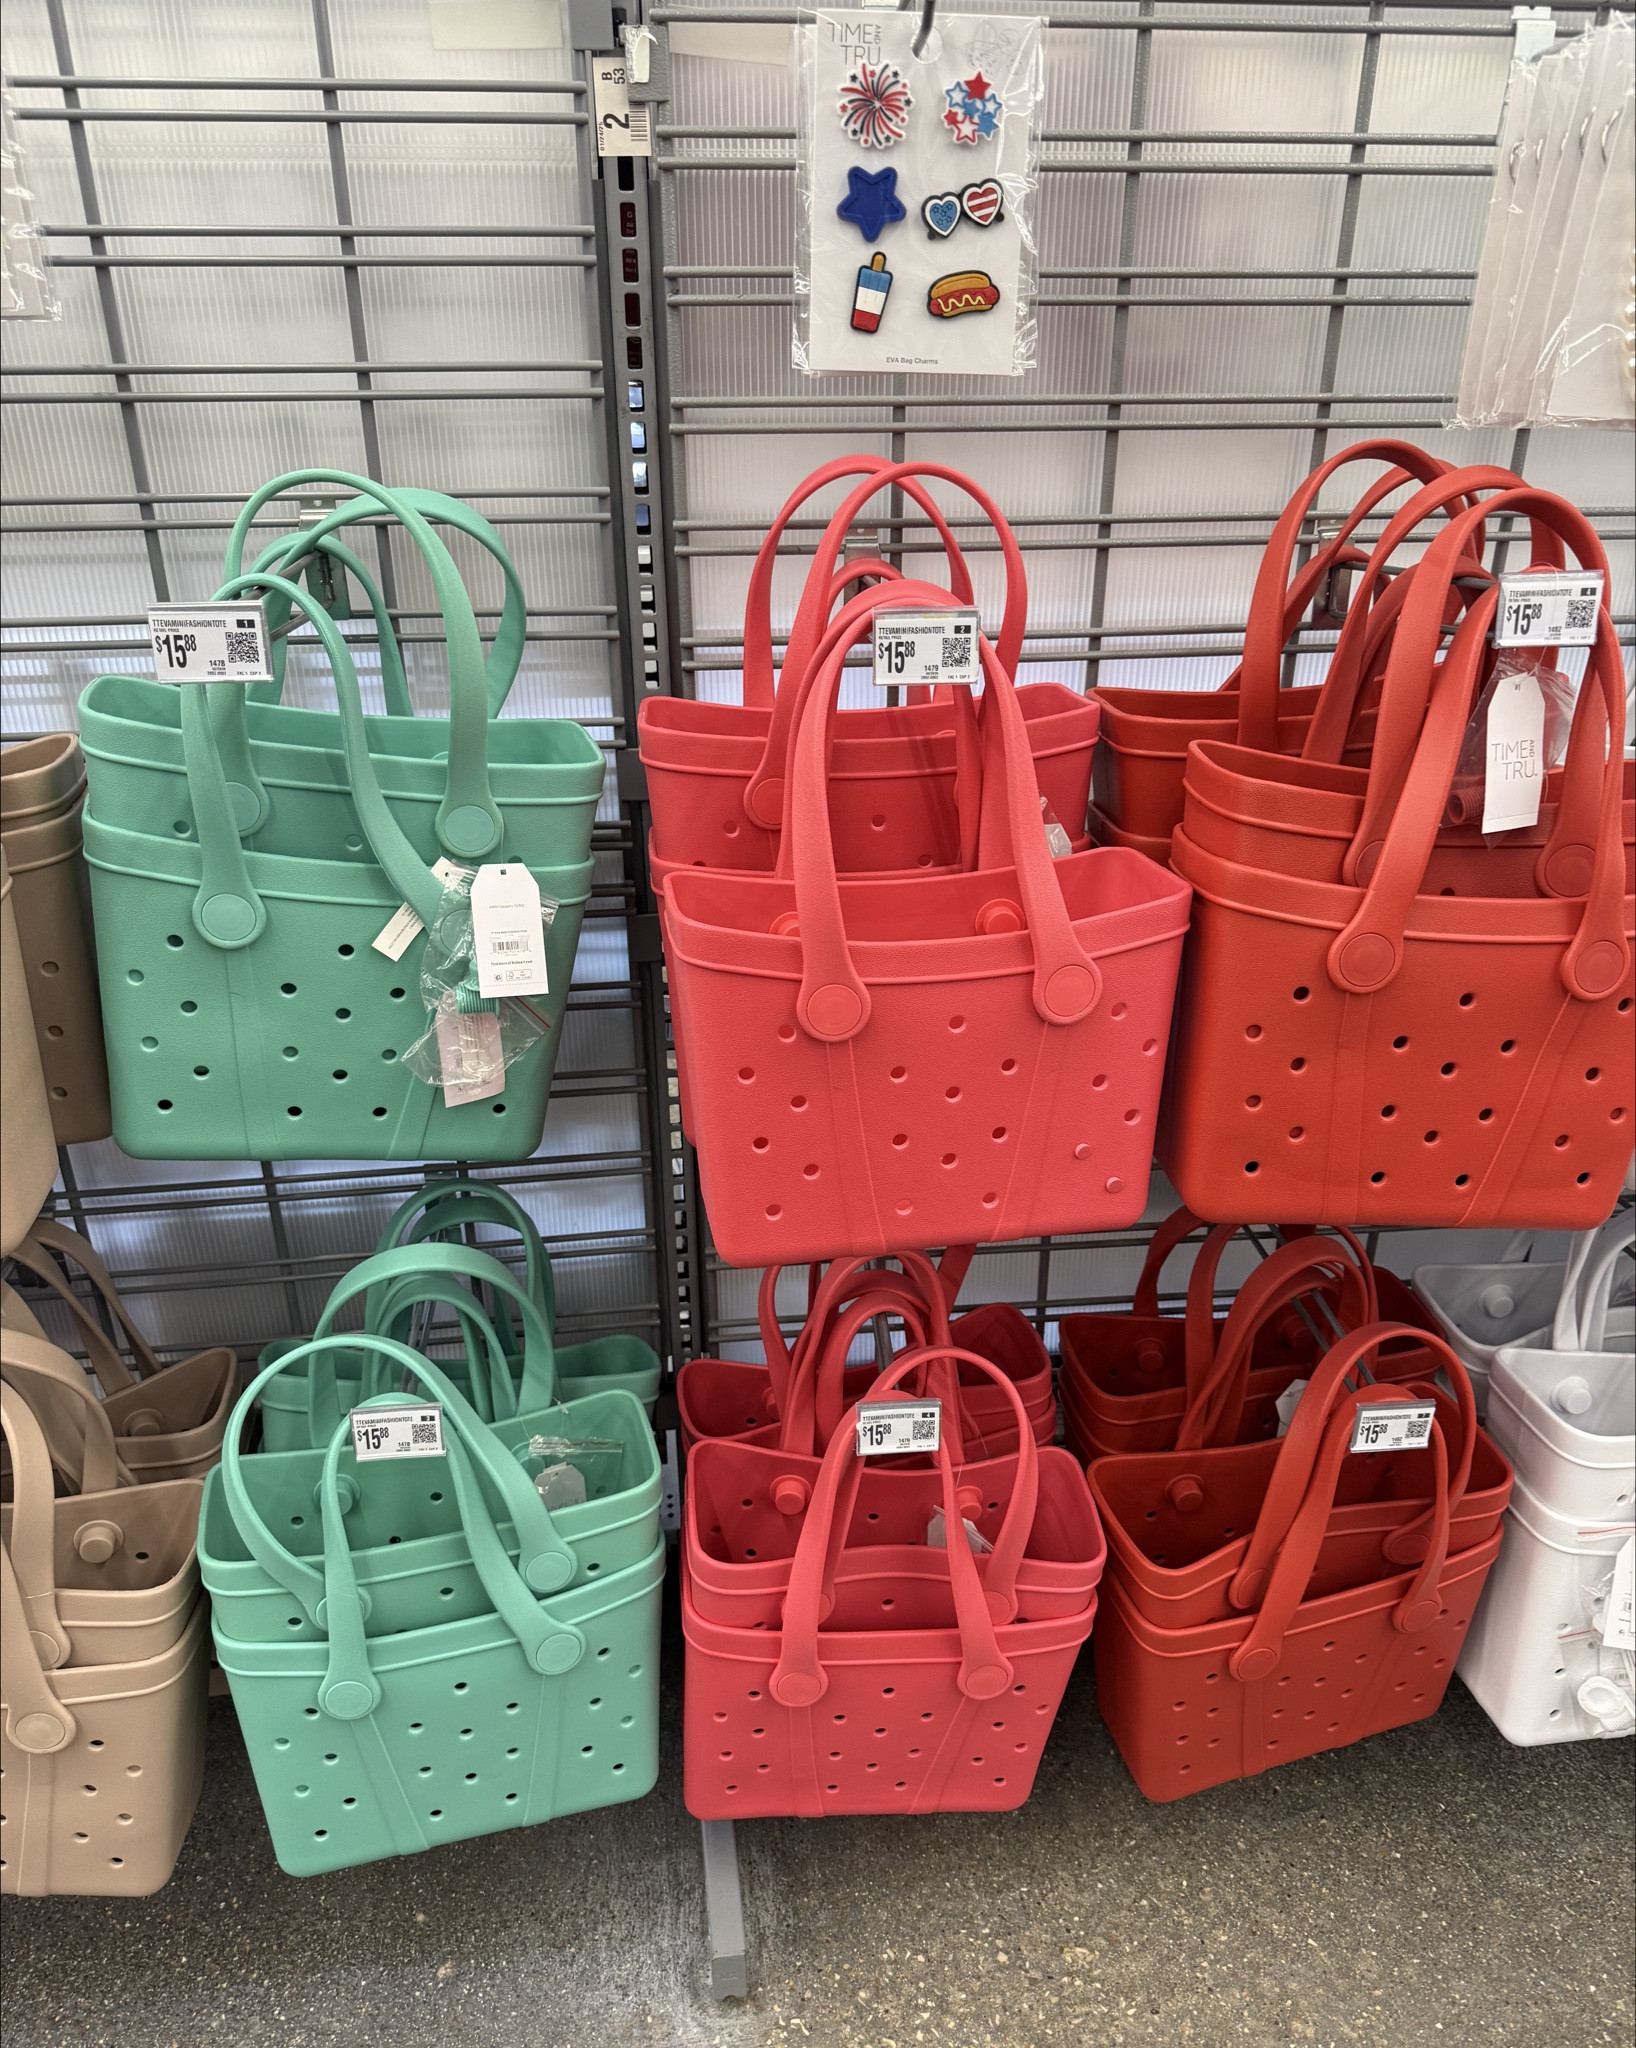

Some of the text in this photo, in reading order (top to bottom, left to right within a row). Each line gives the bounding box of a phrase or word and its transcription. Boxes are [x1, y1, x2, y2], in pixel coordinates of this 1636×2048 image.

[826, 22, 874, 44] TIME
[840, 45, 881, 66] TRU
[601, 71, 613, 81] B
[613, 68, 626, 85] 53
[602, 113, 630, 129] 2
[900, 357, 913, 365] Bag
[152, 619, 227, 628] TTEVAMINIFASHIONTOTE
[243, 620, 248, 628] 1
[960, 625, 965, 634] 2
[878, 627, 945, 635] TTEVAMINIFASHIONTOTE
[1491, 740, 1529, 761] TIME
[1502, 760, 1536, 780] TRU
